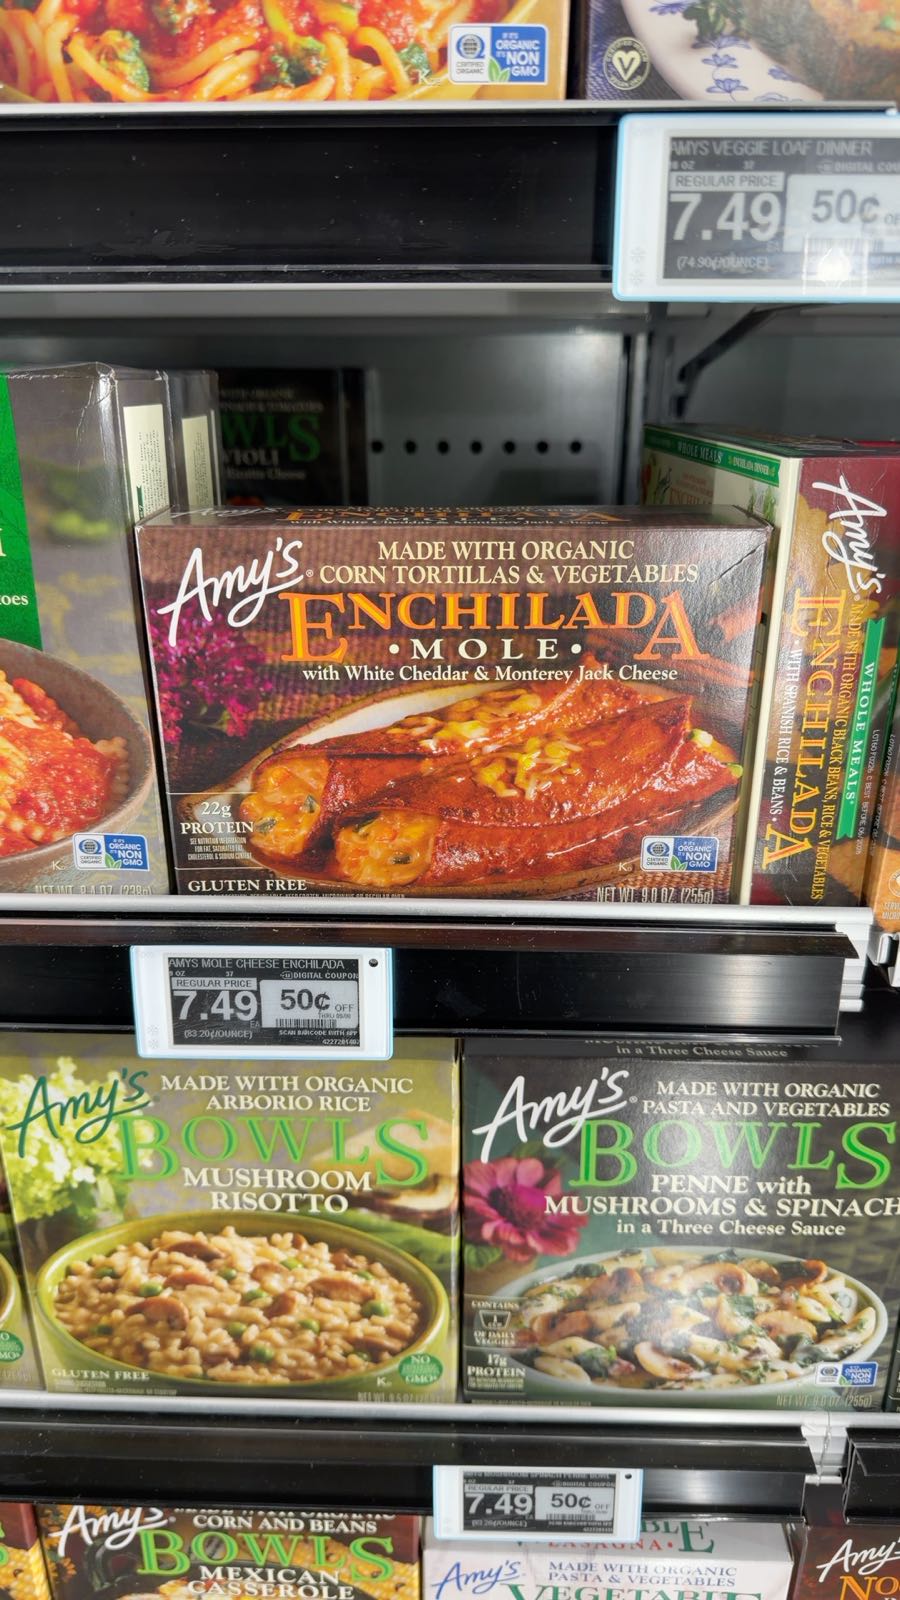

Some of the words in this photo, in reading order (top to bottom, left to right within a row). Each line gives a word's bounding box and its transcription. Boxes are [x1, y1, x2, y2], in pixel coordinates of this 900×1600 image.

[496, 40, 540, 50] ORGANIC
[506, 52, 540, 65] NON
[512, 66, 540, 77] GMO
[712, 141, 769, 156] VEGGIE
[772, 141, 812, 156] LOAF
[816, 142, 872, 157] DINNER
[676, 176, 736, 188] REGULAR
[740, 176, 777, 188] PRICE
[670, 192, 781, 242] 7.49
[700, 448, 723, 464] MEALS
[812, 475, 886, 594] Amy's
[378, 541, 446, 560] MADE
[452, 541, 516, 560] WITH
[522, 540, 635, 560] ORGANIC
[319, 565, 386, 584] CORN
[388, 565, 520, 584] TORTILLAS
[526, 566, 545, 584] &
[551, 564, 699, 584] VEGETABLES
[157, 537, 304, 647] Amy's
[278, 590, 710, 664] ENCHILADA
[786, 649, 802, 680] WITH
[843, 641, 858, 670] WITH
[302, 666, 340, 682] with
[344, 666, 395, 682] White
[399, 665, 469, 682] Cheddar
[474, 666, 490, 681] &
[494, 666, 573, 684] Monterey
[578, 664, 614, 682] Jack
[618, 665, 678, 681] Cheese
[834, 673, 854, 727] ORGANIC
[856, 662, 874, 732] WHOLE
[780, 683, 799, 734] SPANISH
[762, 588, 846, 870] ENCHILADA
[776, 738, 791, 764] RICE
[829, 729, 847, 765] BLACK
[774, 766, 788, 776] &
[846, 740, 864, 800] MEALS
[822, 766, 841, 803] BEANS,
[770, 778, 786, 814] BEANS
[201, 802, 232, 818] 22g
[820, 804, 836, 828] RICE
[180, 822, 254, 835] PROTEIN
[118, 850, 142, 859] NON
[685, 852, 711, 861] NON
[810, 840, 831, 900] VEGETABLES
[188, 880, 260, 892] GLUTEN
[265, 880, 308, 891] FREE
[597, 887, 616, 903] NET
[642, 887, 658, 903] 9.0
[681, 887, 714, 904] (255g)
[169, 959, 198, 968] AMYS
[202, 959, 232, 968] MOLE
[236, 959, 280, 968] CHEESE
[283, 960, 344, 969] ENCHILADA
[173, 991, 258, 1021] 7.49
[281, 989, 330, 1012] 50¢
[617, 1046, 631, 1054] in
[648, 1046, 688, 1056] Three
[692, 1047, 742, 1056] Cheese
[747, 1048, 788, 1057] Sauce
[161, 1075, 230, 1091] MADE
[236, 1076, 300, 1091] WITH
[305, 1076, 413, 1094] ORGANIC
[656, 1081, 717, 1096] MADE
[723, 1082, 779, 1096] WITH
[784, 1083, 880, 1098] ORGANIC
[6, 1067, 150, 1158] Amy's
[206, 1095, 313, 1111] ARBORIO
[320, 1096, 371, 1112] RICE
[642, 1100, 704, 1115] PASTA
[711, 1101, 758, 1116] AND
[763, 1102, 890, 1117] VEGETABLES
[472, 1066, 629, 1164] Amy's
[112, 1115, 429, 1186] BOWLS
[568, 1119, 896, 1190] BOWLS
[182, 1167, 373, 1191] MUSHROOM
[651, 1174, 749, 1194] PENNE
[756, 1176, 812, 1195] with
[210, 1191, 349, 1214] RISOTTO
[544, 1196, 736, 1216] MUSHROOMS
[744, 1198, 768, 1216] &
[776, 1198, 900, 1217] SPINACH
[617, 1220, 635, 1233] in
[641, 1222, 651, 1234] a
[657, 1219, 714, 1234] Three
[719, 1220, 785, 1235] Cheese
[791, 1221, 846, 1236] Sauce
[471, 1300, 520, 1309] CONTAINS
[410, 1355, 430, 1364] NO
[52, 1368, 110, 1379] GLUTEN
[115, 1370, 149, 1380] FREE
[467, 1366, 526, 1377] PROTEIN
[777, 1395, 795, 1406] NET
[846, 1395, 872, 1407] (255g)
[465, 1493, 532, 1515] 7.49
[49, 1505, 168, 1557] Amys
[193, 1515, 253, 1530] CORN
[259, 1517, 305, 1531] AND
[310, 1519, 377, 1533] BEANS
[137, 1529, 394, 1582] BOWLS
[200, 1566, 340, 1584] MEXICAN
[549, 1561, 598, 1572] MADE
[603, 1563, 648, 1573] WITH
[653, 1565, 737, 1576] ORGANIC
[431, 1560, 521, 1600] Amy's
[549, 1572, 600, 1583] PASTA
[608, 1574, 621, 1584] &
[628, 1574, 735, 1586] VEGETABLES
[187, 1581, 354, 1600] CASSEROLE
